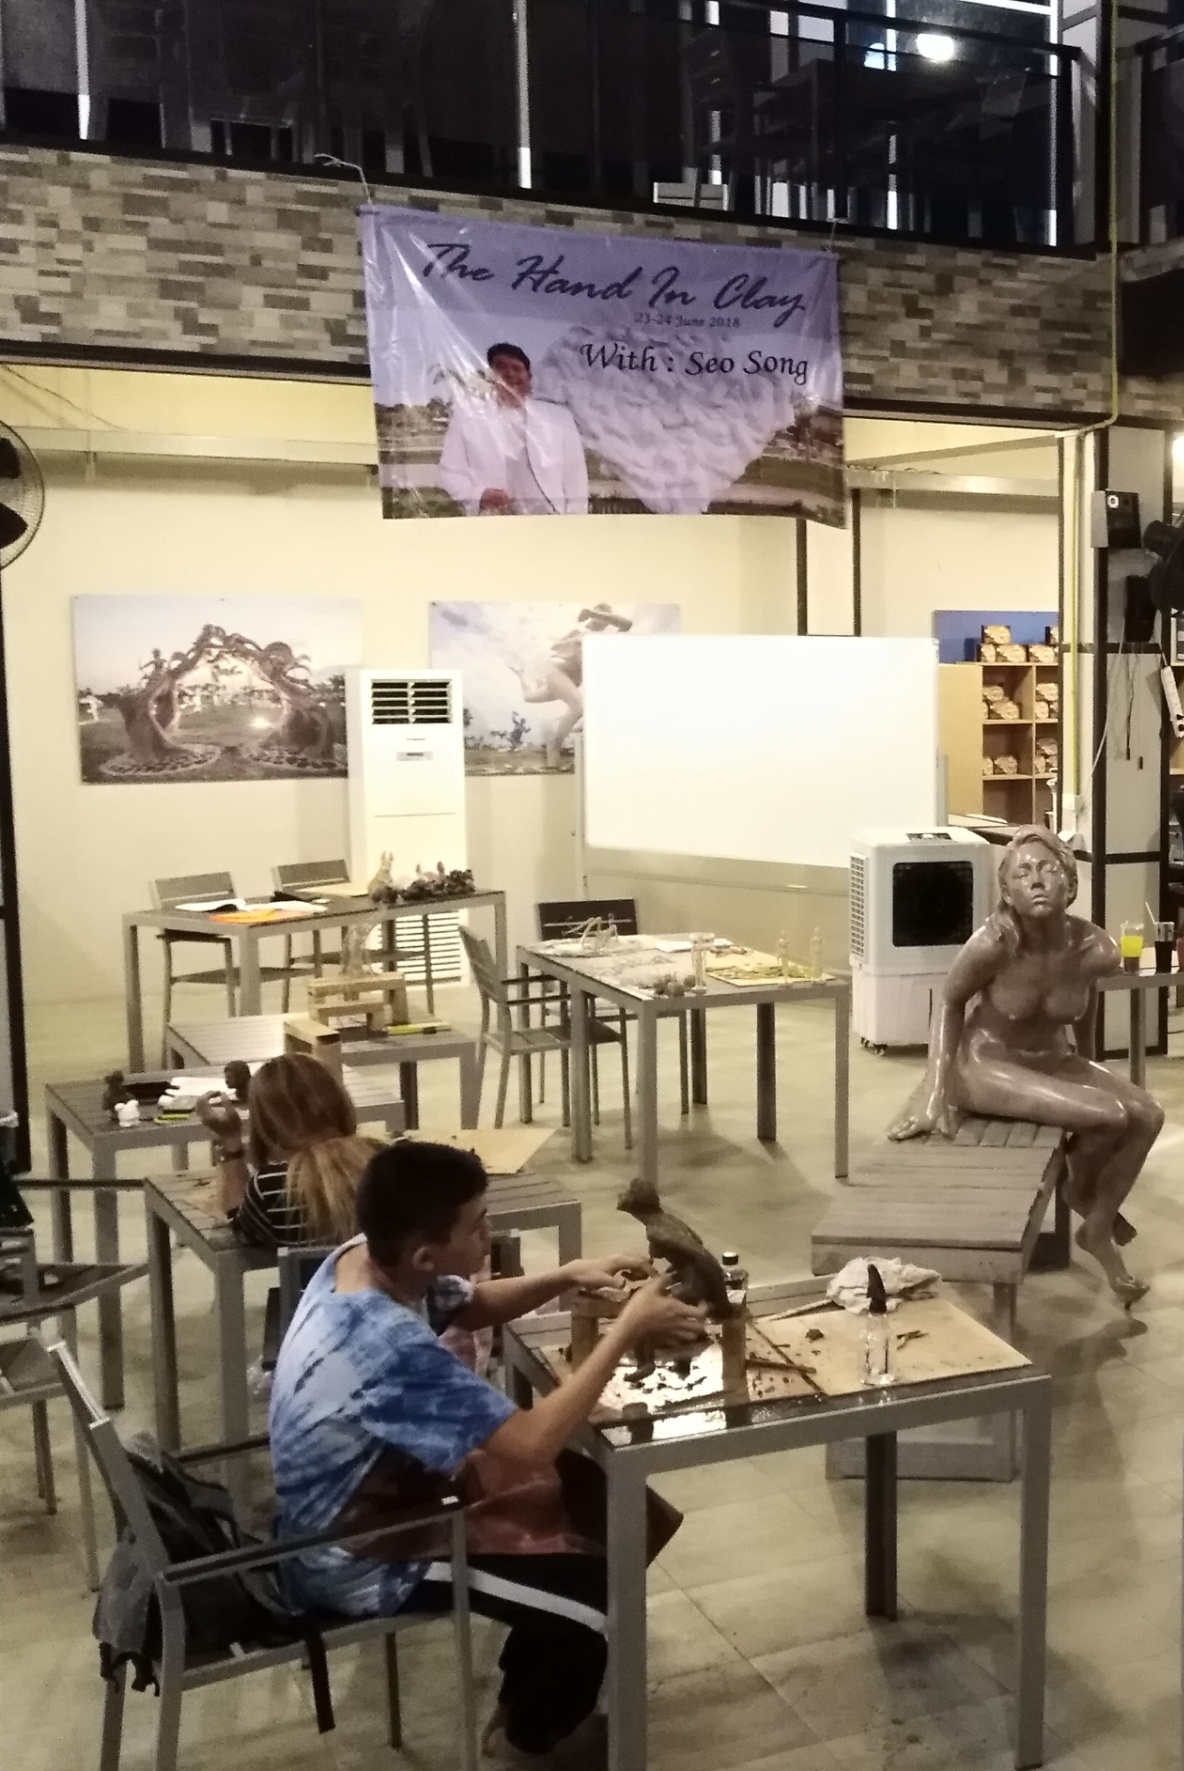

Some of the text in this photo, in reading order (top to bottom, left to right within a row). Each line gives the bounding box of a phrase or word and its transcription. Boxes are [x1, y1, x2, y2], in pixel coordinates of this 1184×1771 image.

[422, 243, 806, 328] The Hand In Clay
[635, 312, 740, 328] 23-24 June 2018
[579, 342, 658, 371] With
[684, 351, 735, 376] Seo
[743, 350, 808, 386] Song
